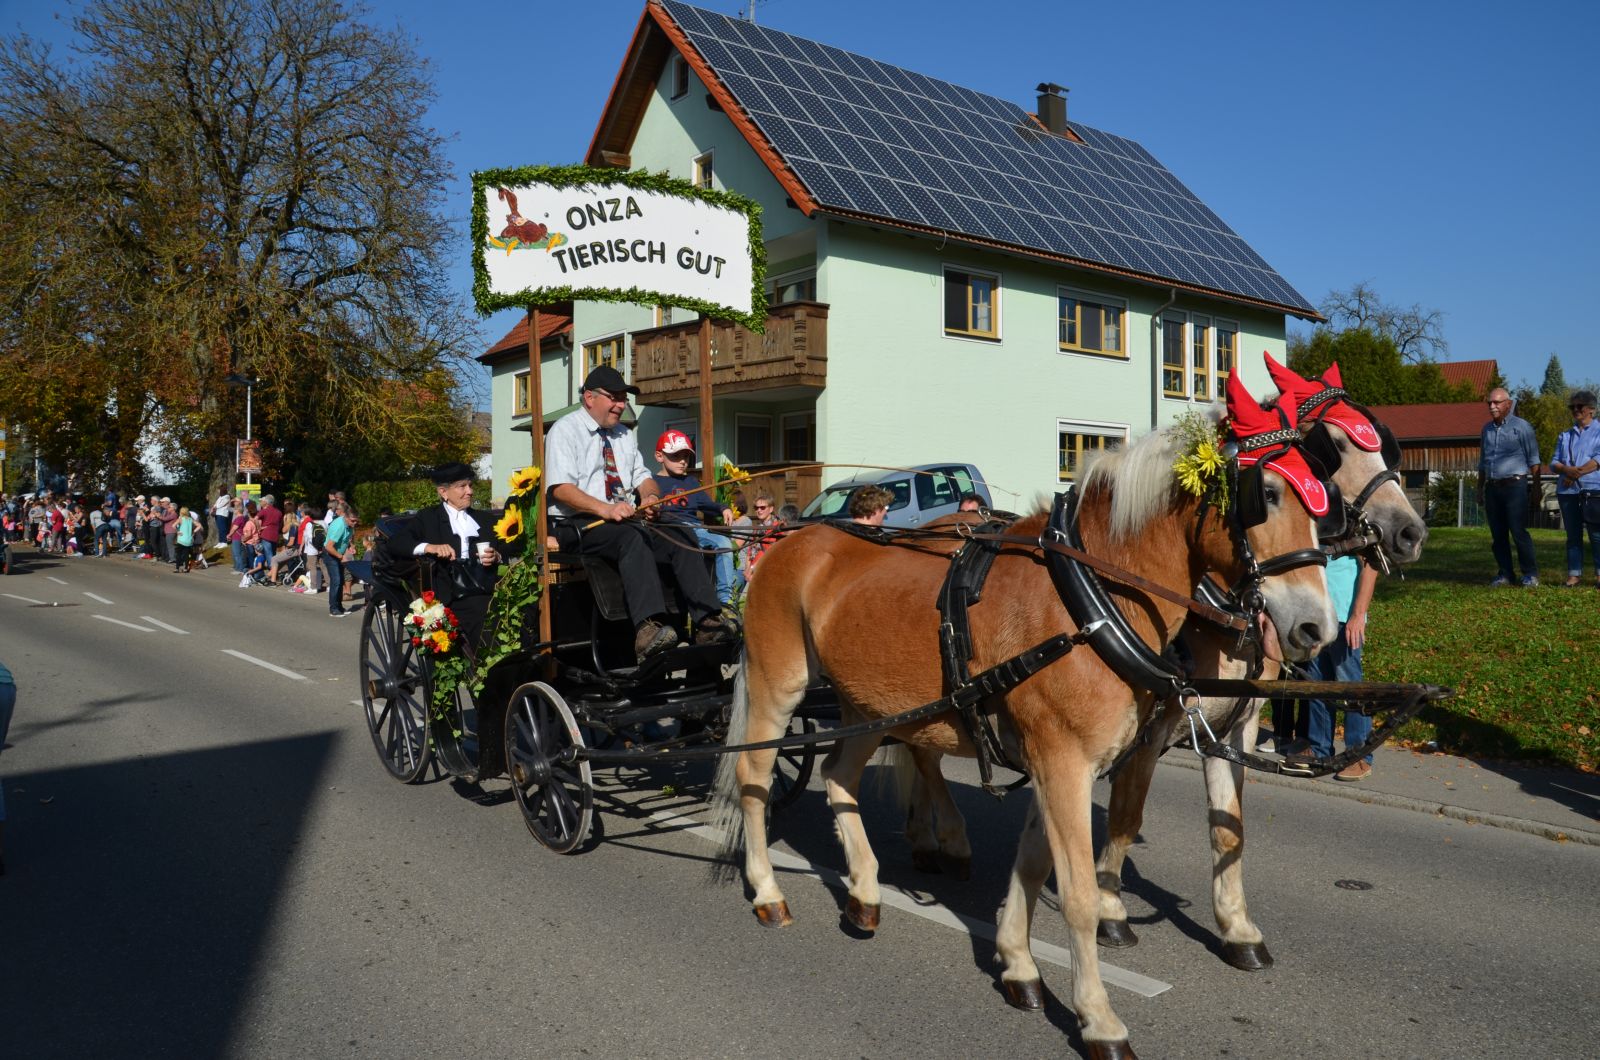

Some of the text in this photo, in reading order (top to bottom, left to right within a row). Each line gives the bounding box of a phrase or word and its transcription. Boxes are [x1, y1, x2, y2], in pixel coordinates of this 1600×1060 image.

[566, 195, 643, 230] ONZA
[552, 238, 727, 279] TIERISCH GUT
